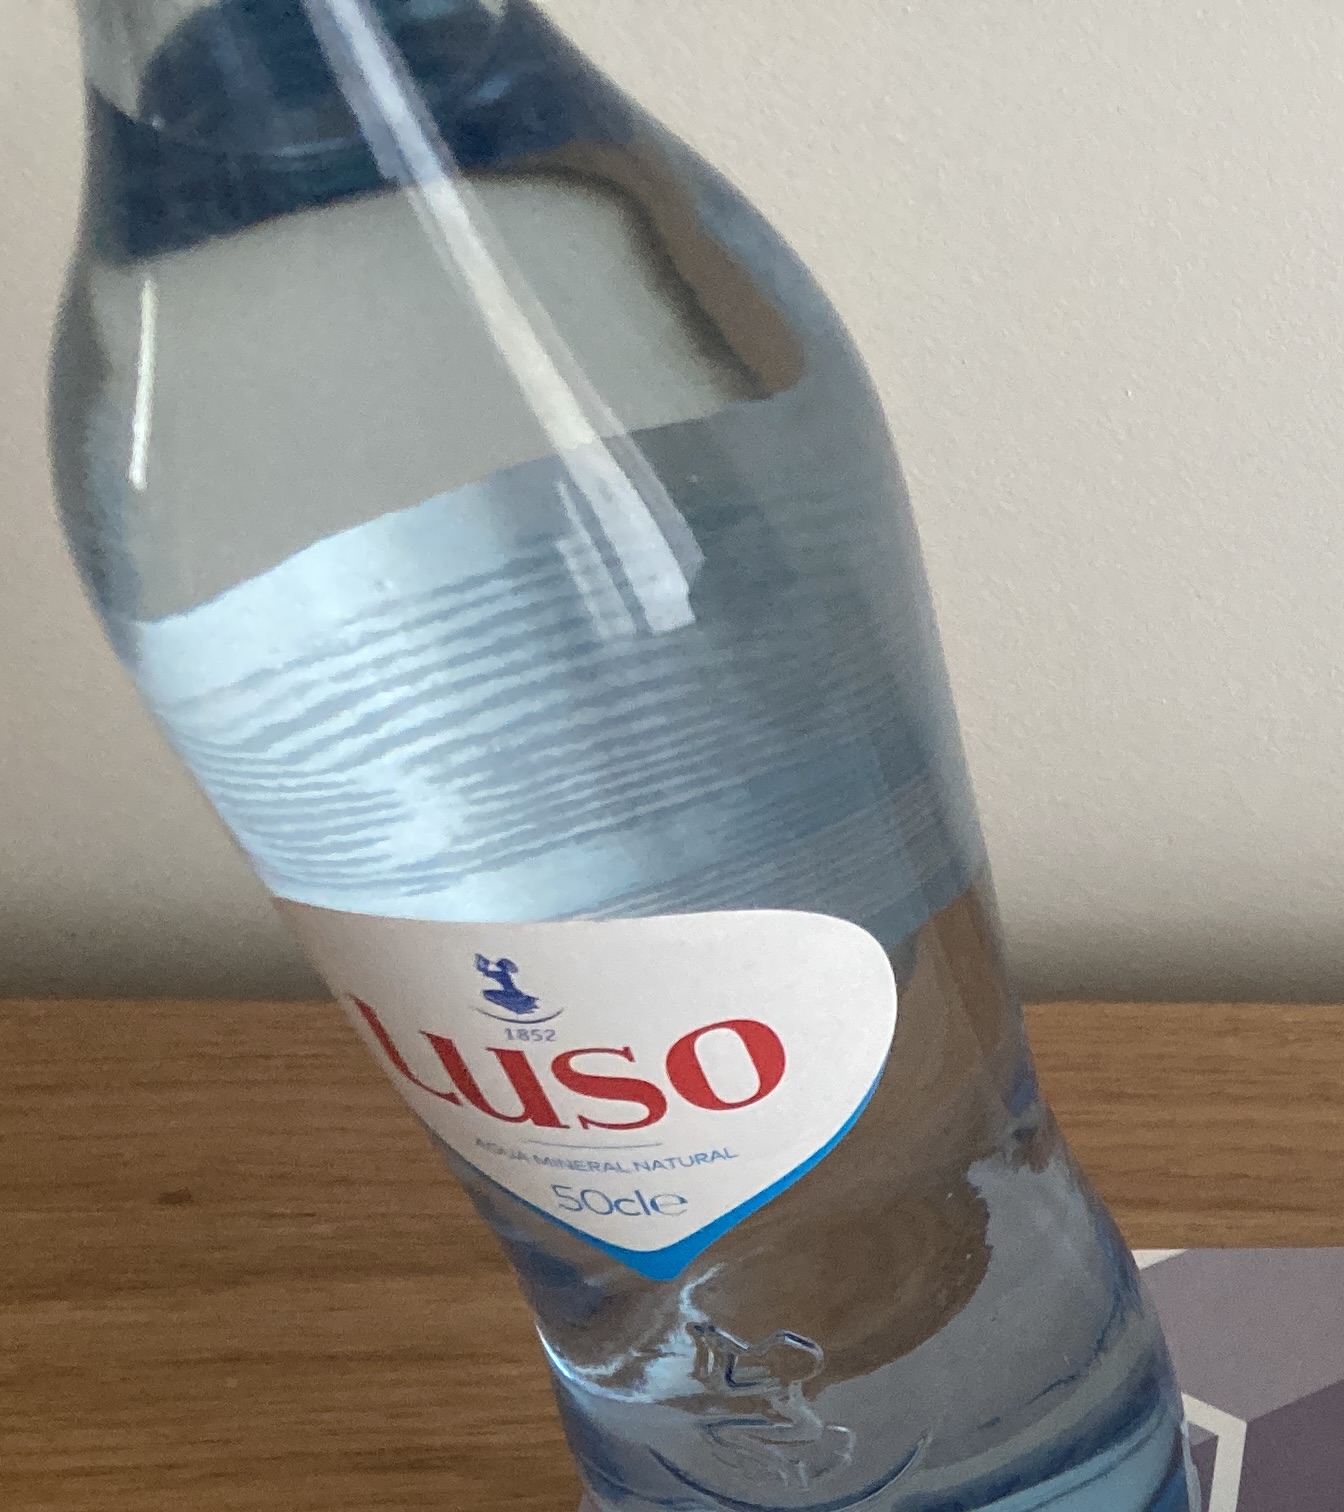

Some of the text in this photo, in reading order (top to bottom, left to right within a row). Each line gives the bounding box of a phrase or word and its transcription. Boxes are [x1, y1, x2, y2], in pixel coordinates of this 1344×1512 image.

[503, 1027, 557, 1043] 1852
[532, 1154, 634, 1174] MINERAL
[633, 1147, 739, 1173] NATURAL
